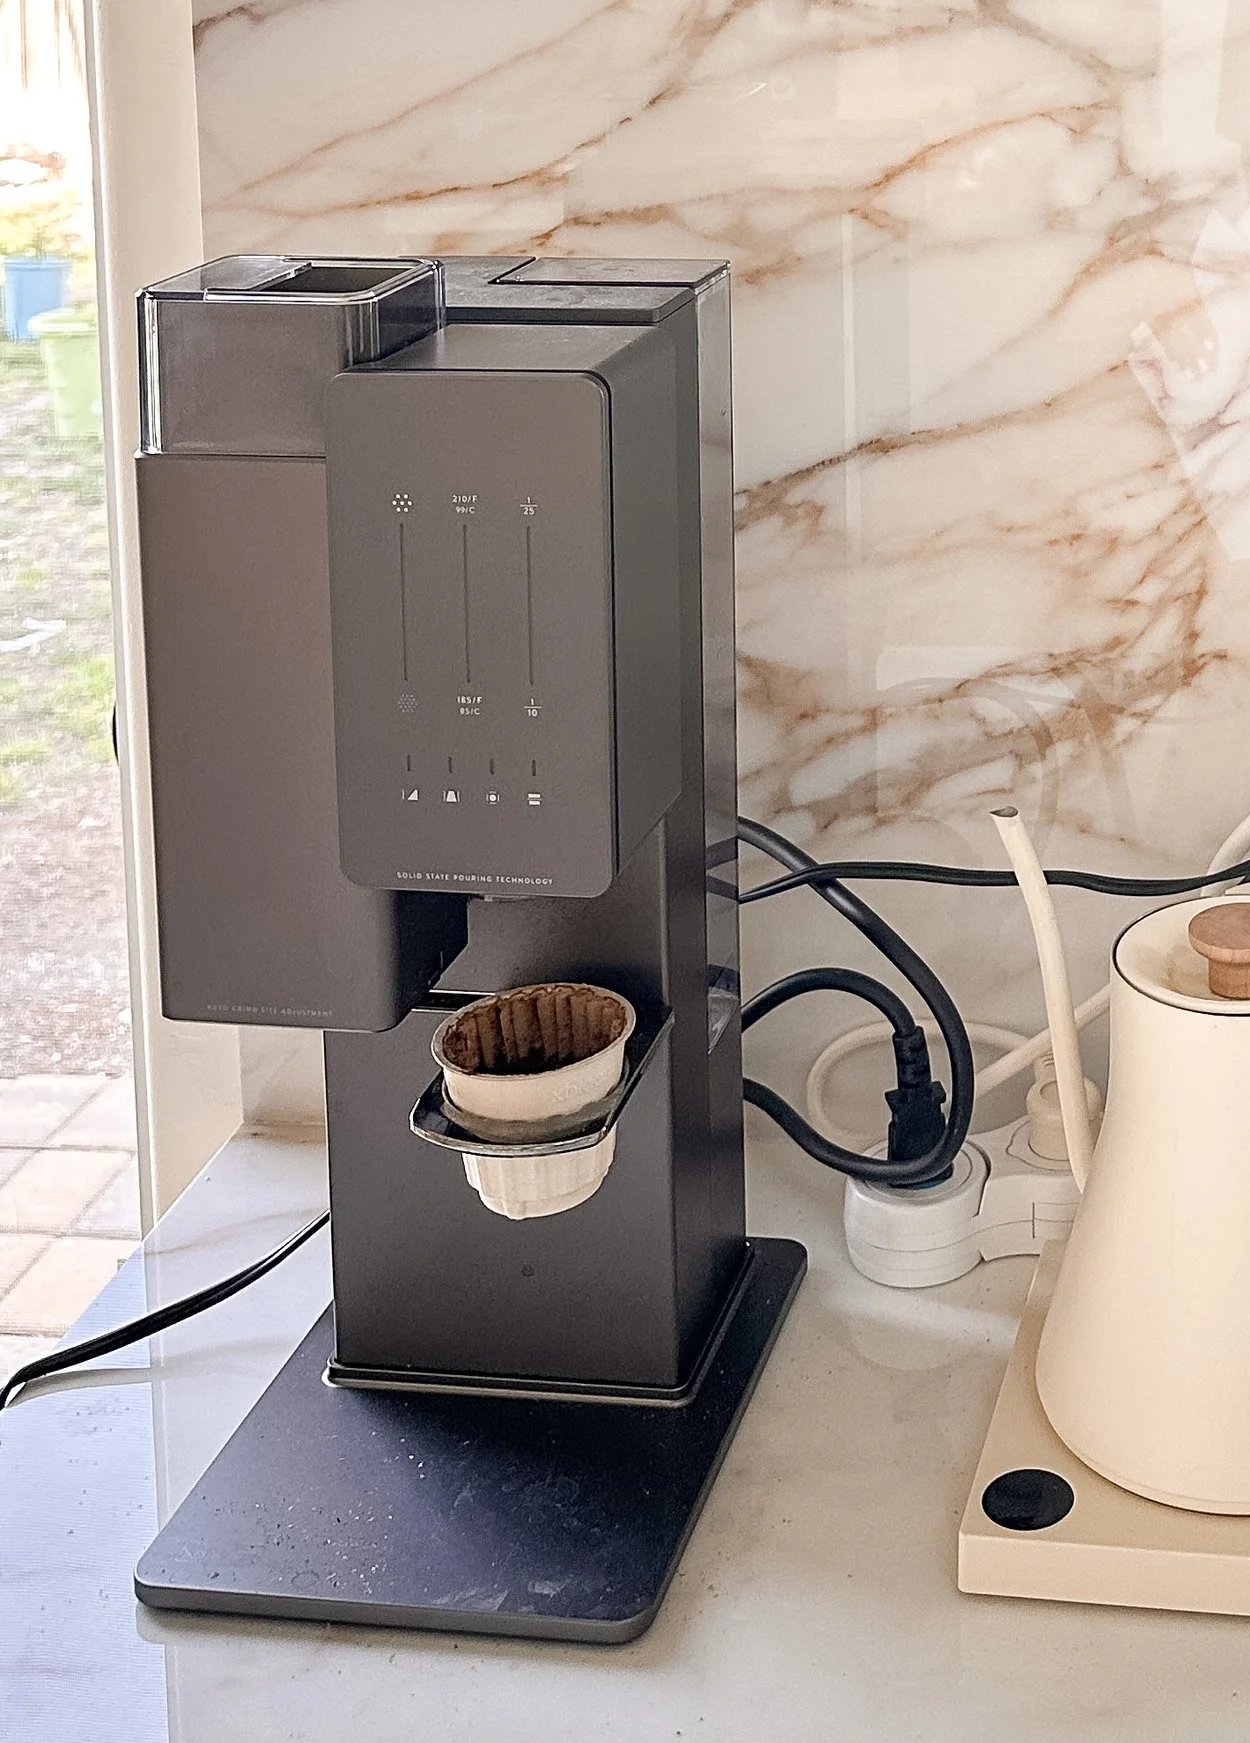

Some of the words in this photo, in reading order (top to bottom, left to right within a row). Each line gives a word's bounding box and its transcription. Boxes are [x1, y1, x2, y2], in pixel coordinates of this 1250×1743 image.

[452, 495, 478, 503] 210/F
[455, 506, 476, 514] 99/C
[523, 507, 535, 515] 25
[527, 709, 538, 717] 10
[426, 873, 450, 881] STATE
[496, 877, 553, 885] TECHNOLOGY
